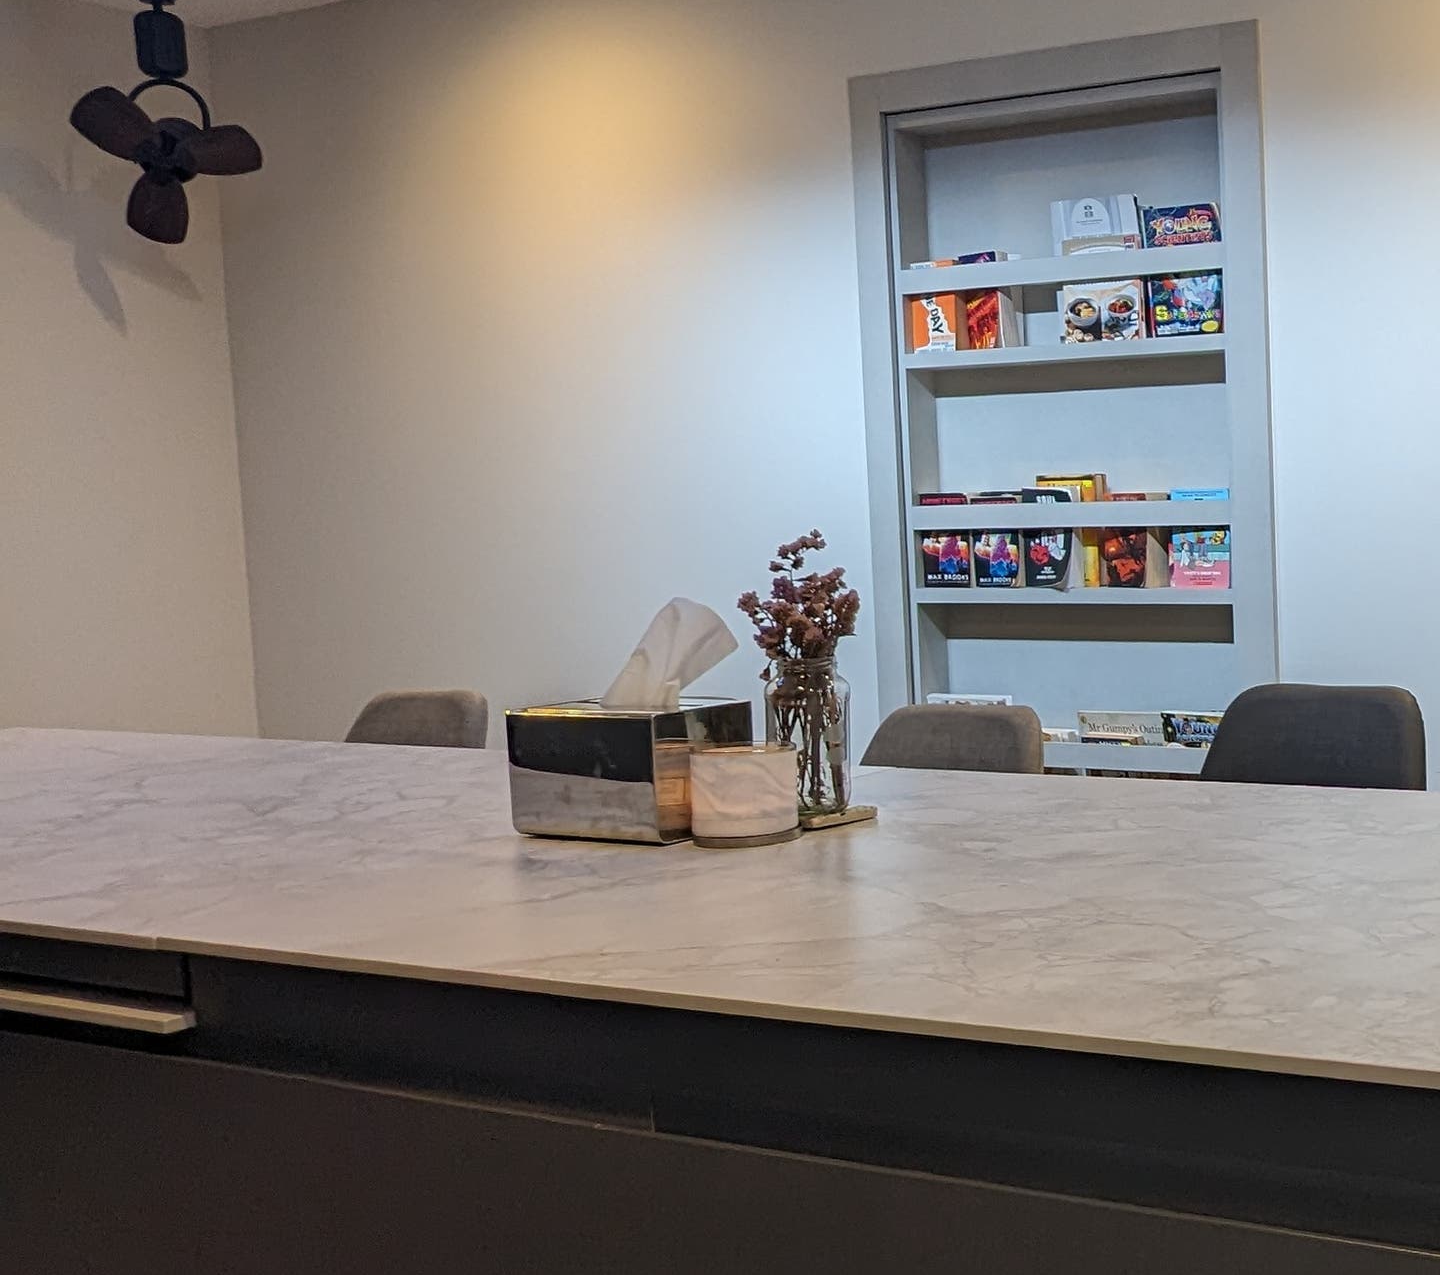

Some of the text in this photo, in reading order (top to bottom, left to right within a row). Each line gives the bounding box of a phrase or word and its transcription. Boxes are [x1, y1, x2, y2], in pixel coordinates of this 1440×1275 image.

[930, 308, 944, 334] DAY
[1088, 723, 1163, 734] Mr Gumpy's Outin
